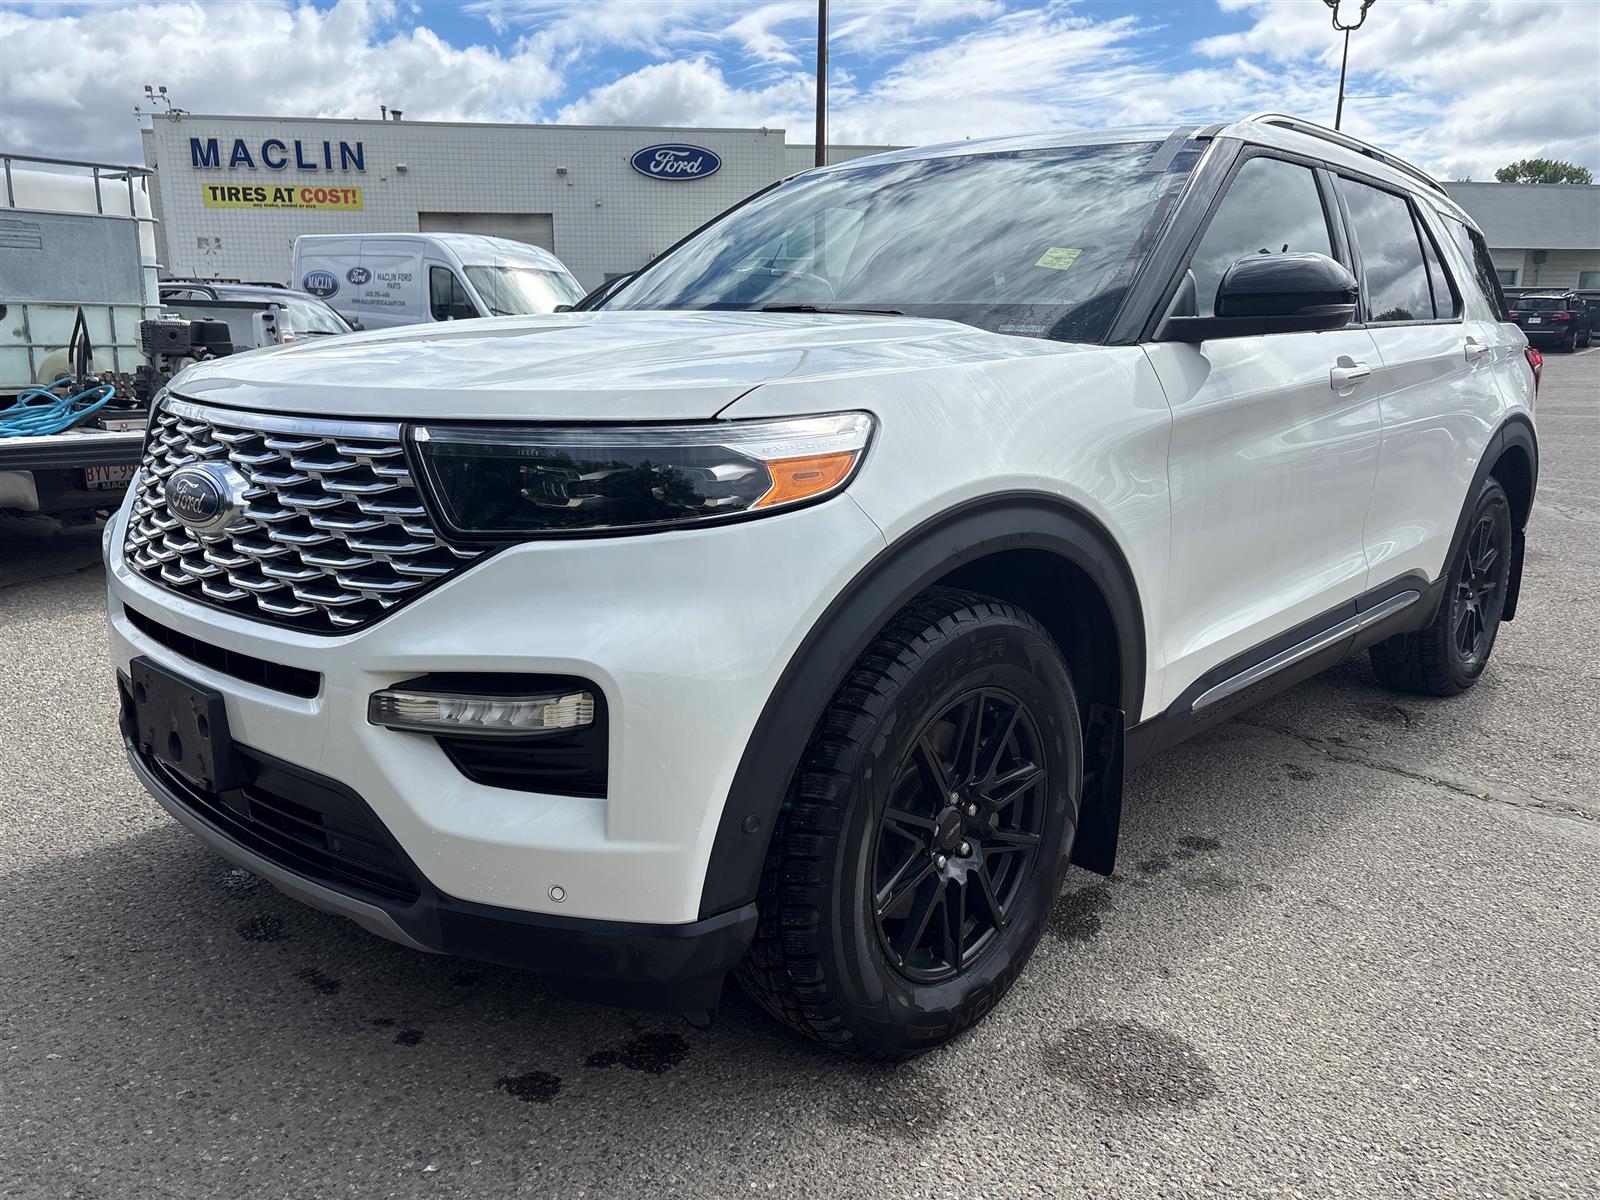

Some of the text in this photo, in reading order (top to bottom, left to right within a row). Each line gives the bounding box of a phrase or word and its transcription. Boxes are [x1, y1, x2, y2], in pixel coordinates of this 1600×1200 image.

[190, 137, 366, 172] MACLIN
[650, 150, 703, 173] Ford
[209, 186, 357, 204] TIRES AT COST!
[377, 273, 397, 282] MACLIN
[398, 273, 412, 282] FORD
[387, 282, 401, 290] PARTS
[762, 438, 849, 454] EXPLORER
[173, 479, 206, 513] Ford
